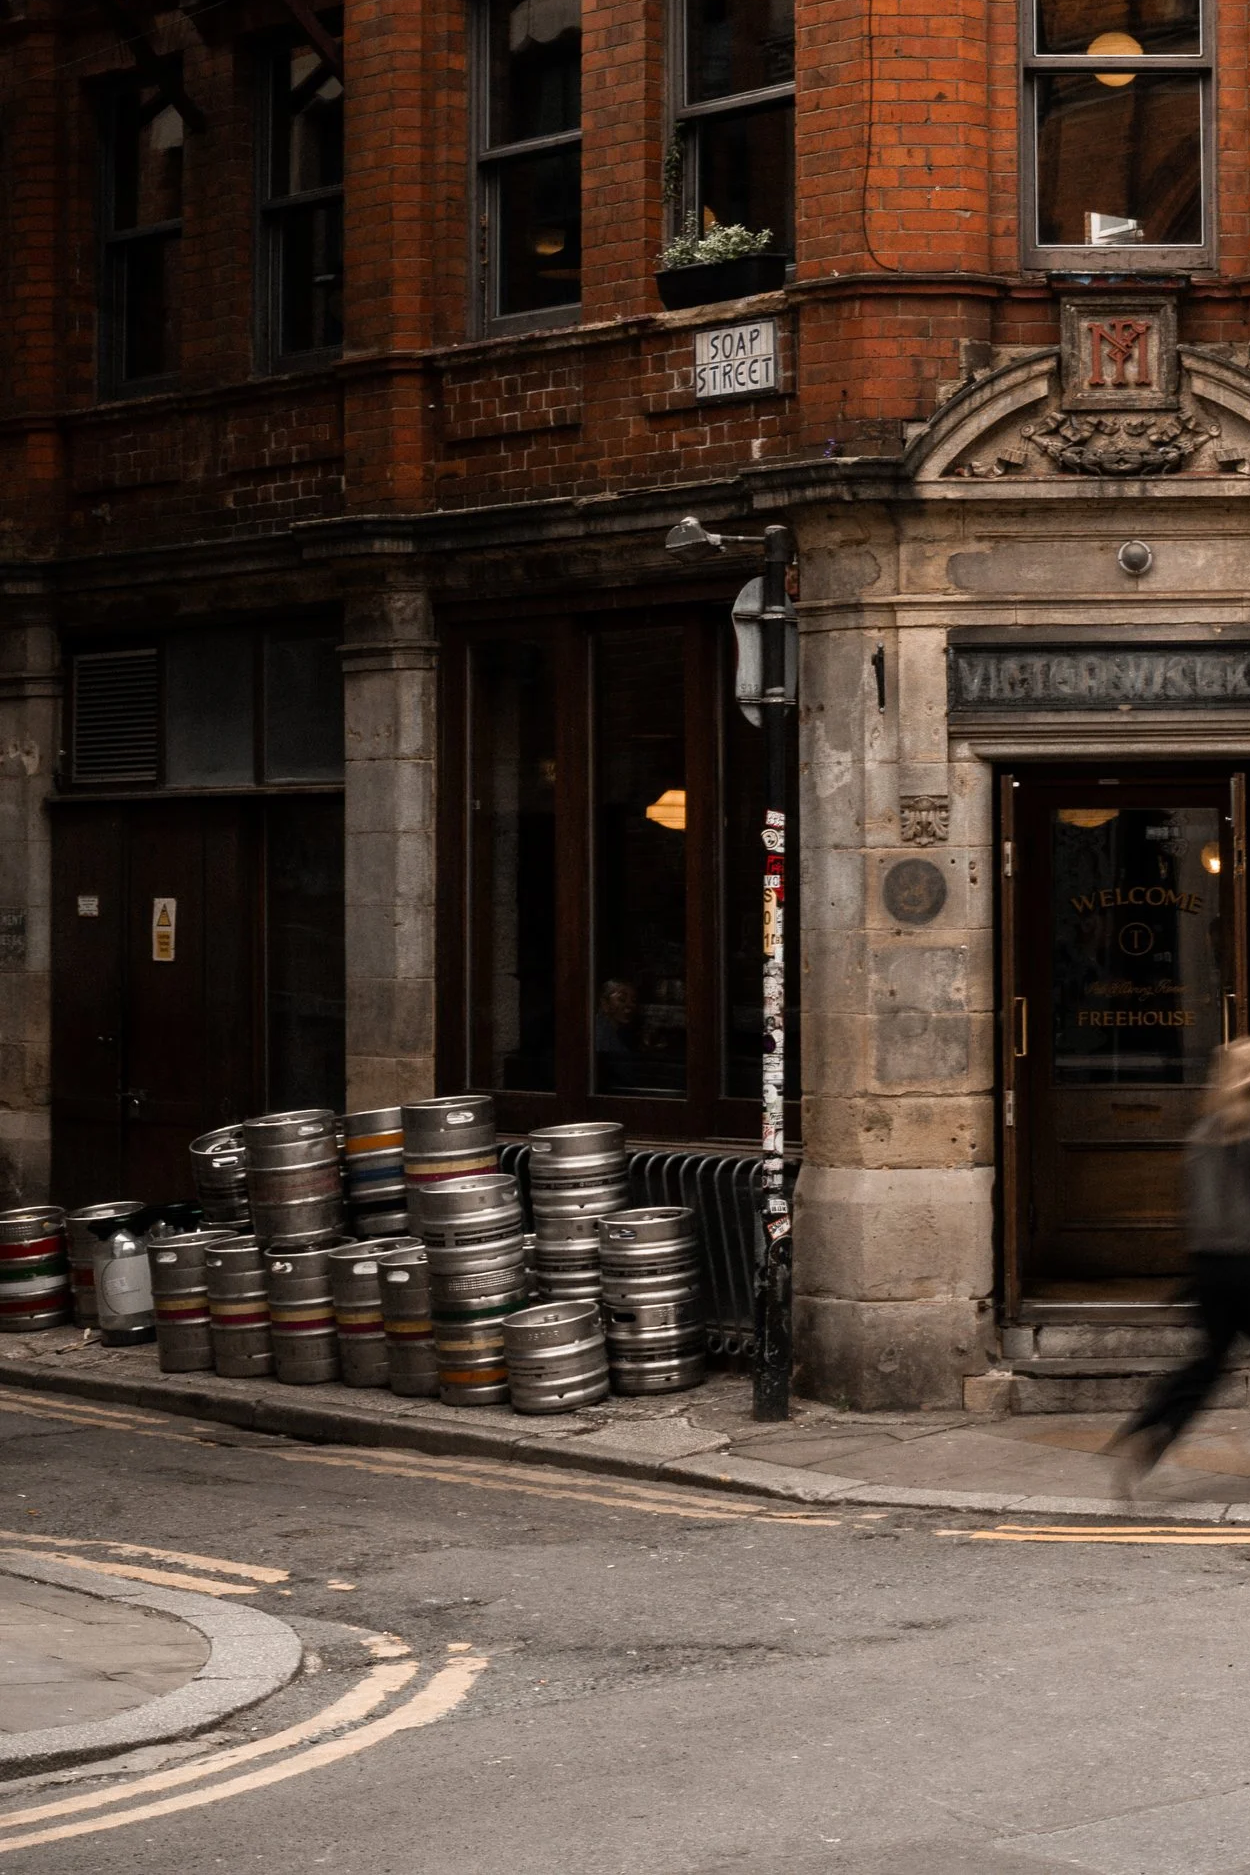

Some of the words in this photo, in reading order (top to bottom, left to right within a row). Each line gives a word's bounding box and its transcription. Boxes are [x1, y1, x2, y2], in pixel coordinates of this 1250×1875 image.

[711, 328, 760, 360] SOAP
[698, 357, 772, 393] STREET
[1070, 886, 1204, 916] WELCOME
[1077, 1011, 1197, 1027] FREEHOUSE
